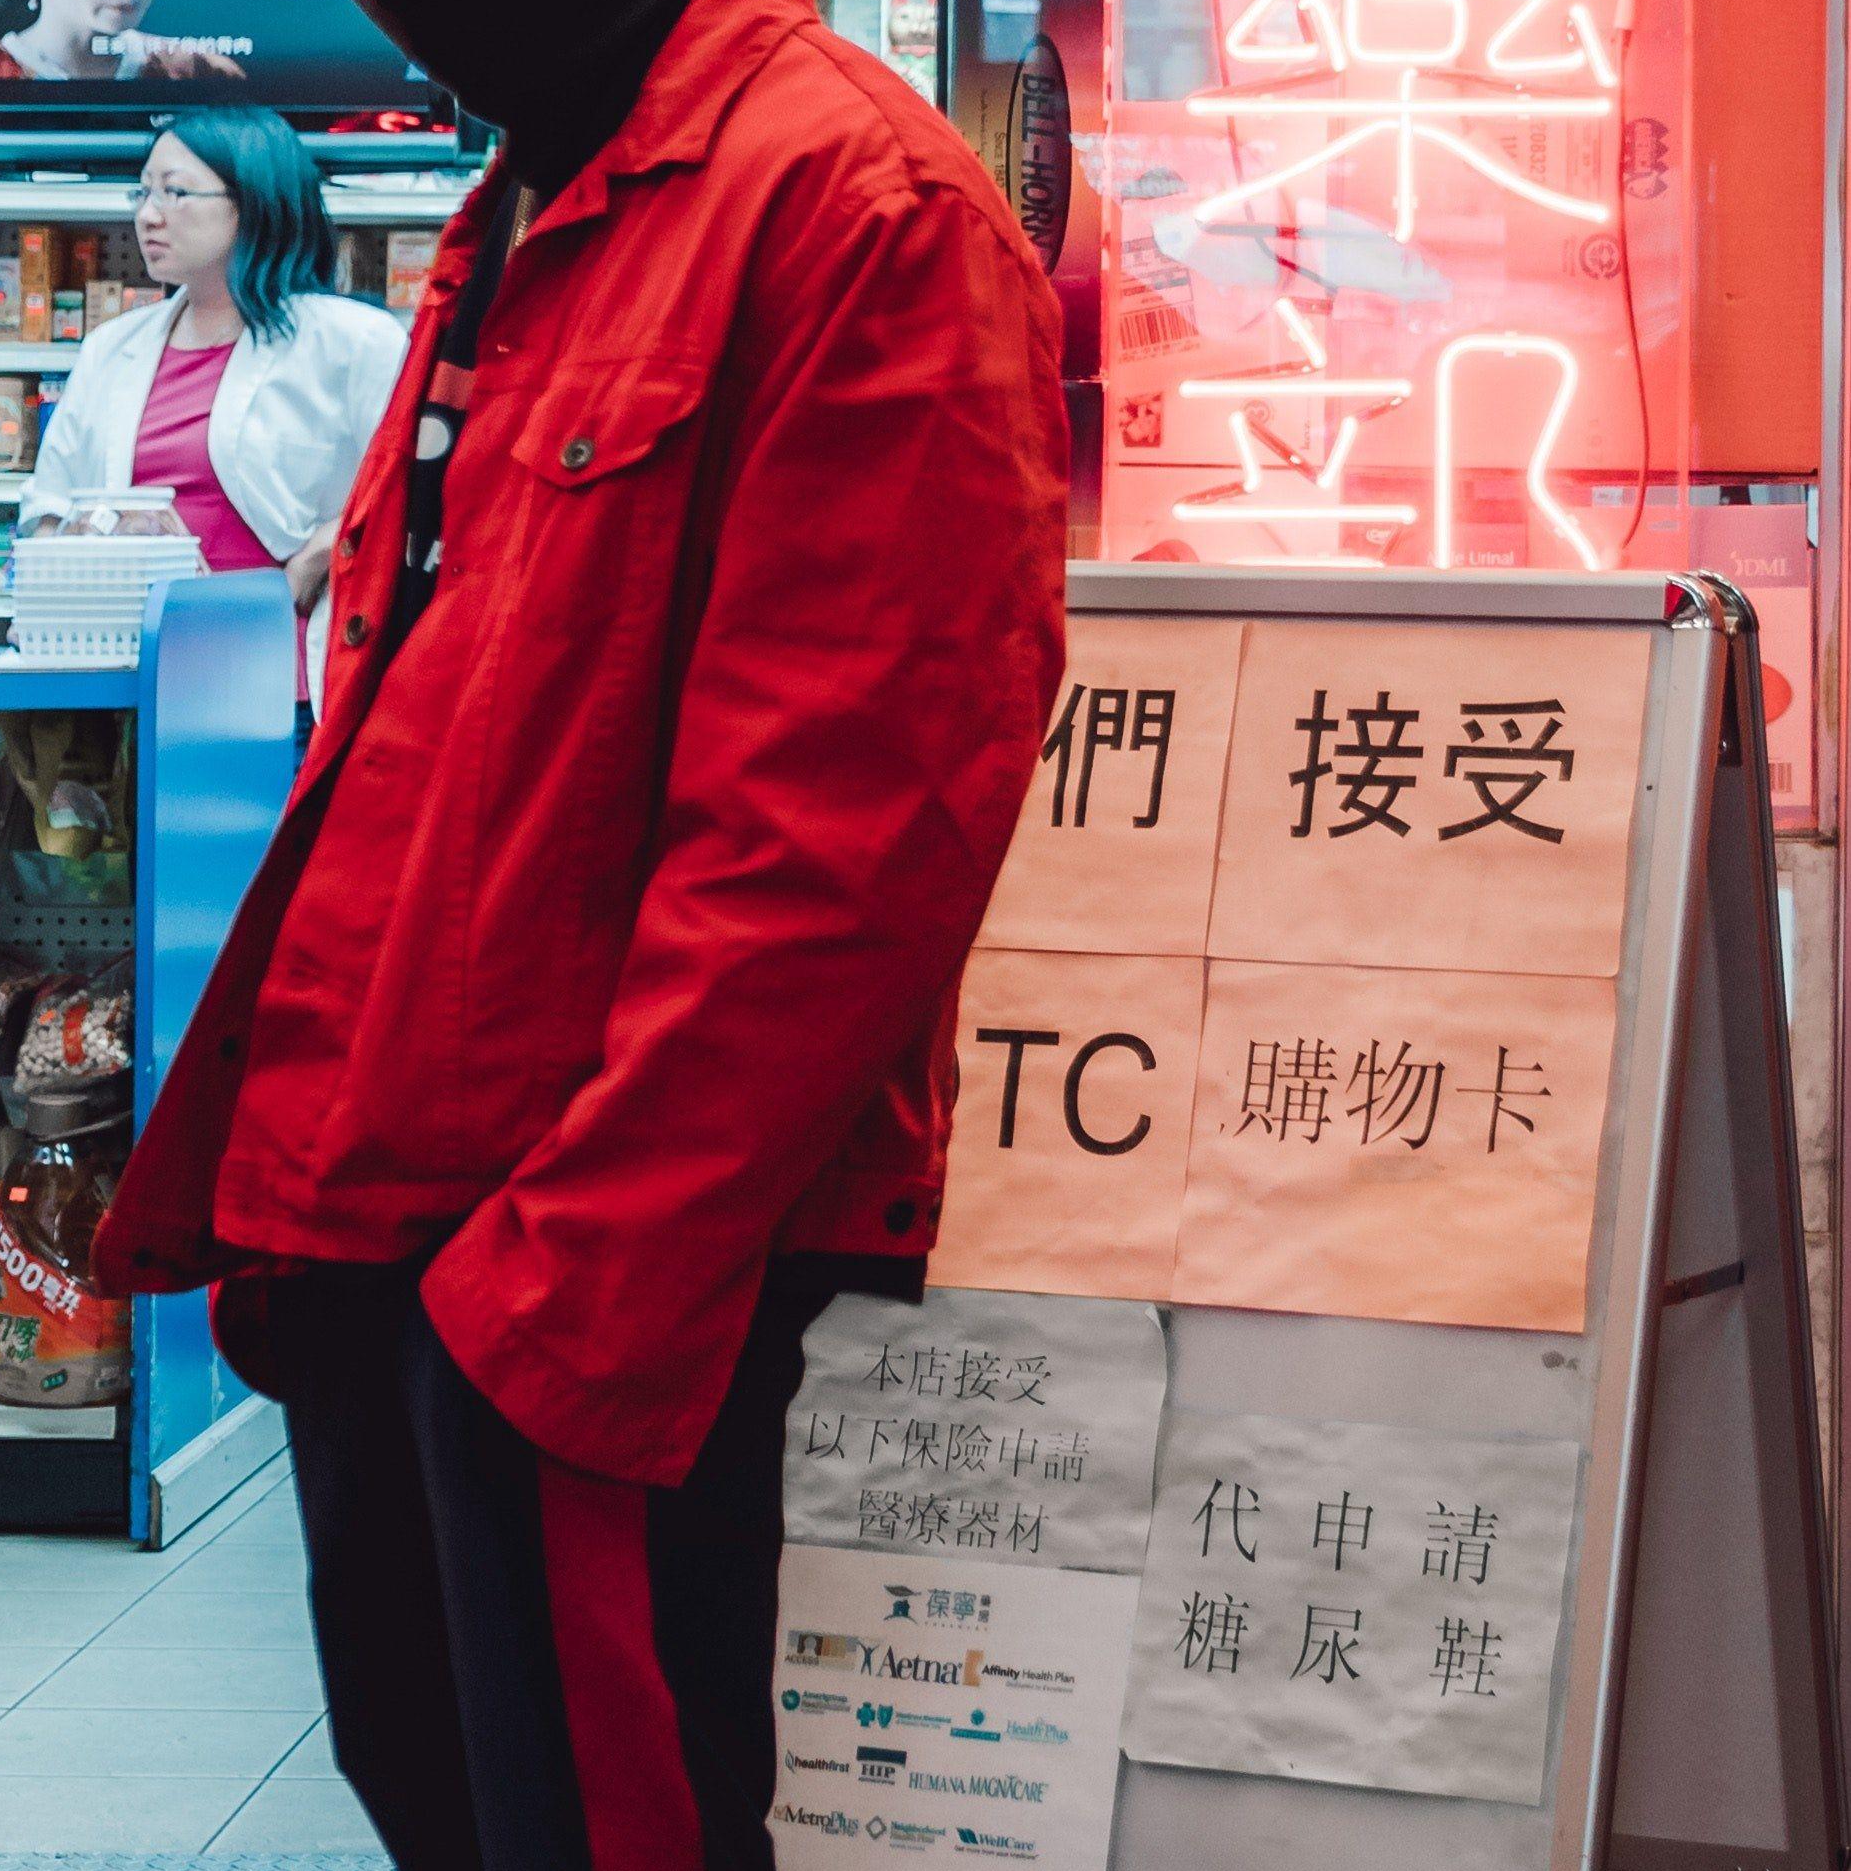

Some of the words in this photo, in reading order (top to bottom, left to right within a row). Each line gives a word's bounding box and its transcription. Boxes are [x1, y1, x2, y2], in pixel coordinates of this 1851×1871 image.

[1469, 549, 1514, 566] Urinal
[1286, 688, 1576, 846] 接受
[953, 1027, 1157, 1156] TC
[1236, 1036, 1552, 1156] 購物卡
[862, 1341, 1054, 1407] 本店接受
[802, 1410, 1092, 1484] 以下保險申請
[856, 1486, 1051, 1557] 醫療器材
[1190, 1477, 1500, 1586] 代申請
[879, 1645, 960, 1686] Aetna
[982, 1664, 1020, 1681] Affinity
[1022, 1669, 1053, 1682] Health
[1054, 1672, 1076, 1684] Plan
[1174, 1590, 1506, 1700] 糖尿鞋
[793, 1755, 850, 1774] healthfirst
[861, 1762, 896, 1779] HIP
[784, 1804, 860, 1831] MetroPlus
[979, 1833, 1035, 1851] WellCare
